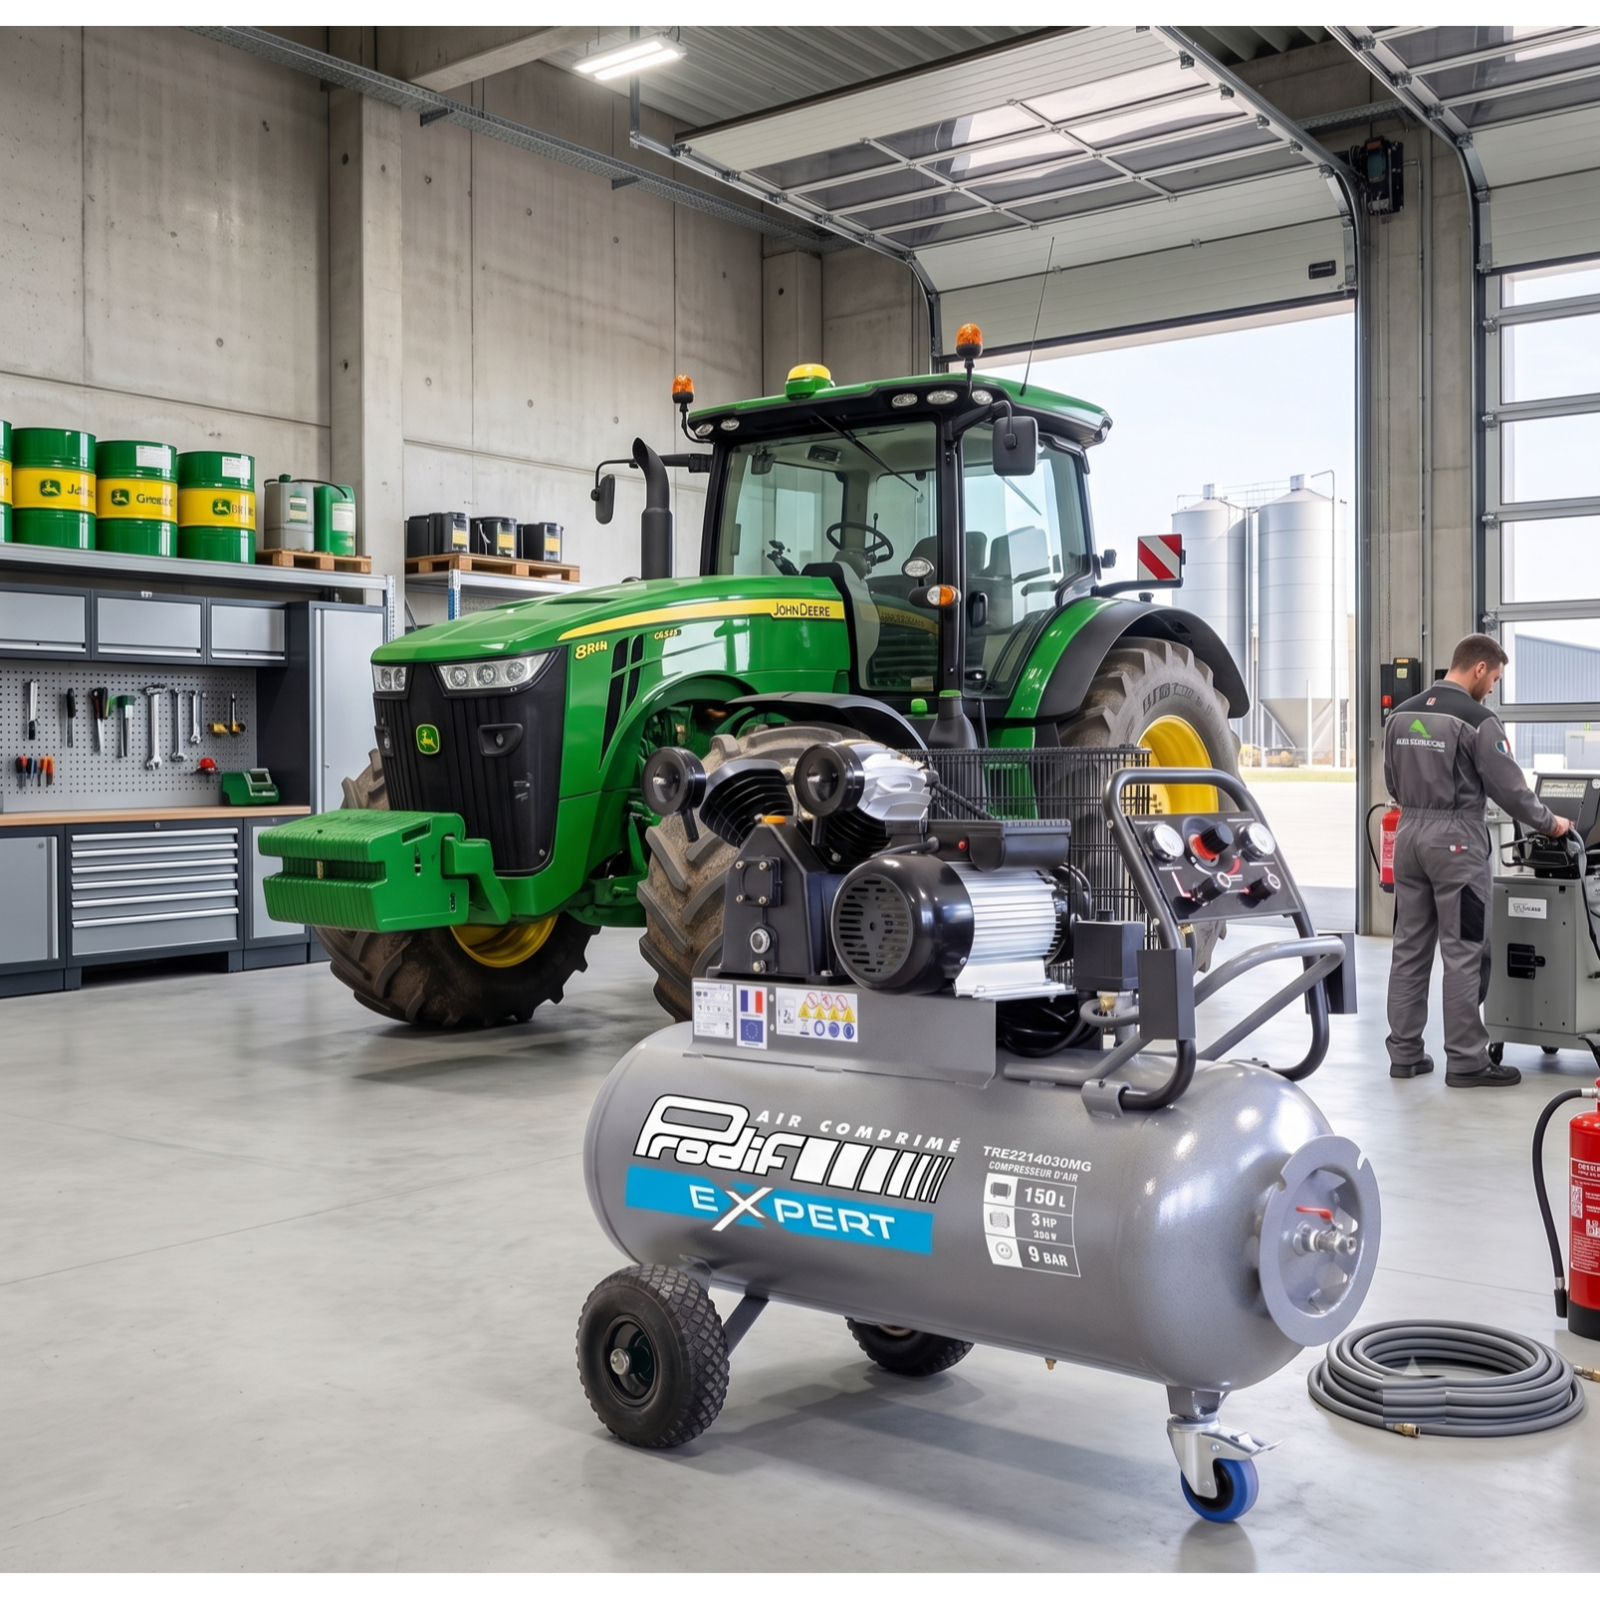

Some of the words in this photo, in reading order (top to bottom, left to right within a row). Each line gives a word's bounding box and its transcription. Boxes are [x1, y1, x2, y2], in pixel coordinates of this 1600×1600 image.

[633, 1093, 807, 1176] Prodif
[756, 1110, 802, 1128] AIR
[819, 1119, 961, 1153] COMPRIMÉ
[983, 1145, 1092, 1172] TRE2214030MG
[988, 1160, 1052, 1179] COMPRESSEUR
[1053, 1172, 1079, 1182] D'AIR
[1024, 1186, 1057, 1207] 150
[1058, 1195, 1067, 1208] L
[688, 1184, 896, 1240] EXPERT
[1031, 1213, 1041, 1227] 3
[1042, 1217, 1058, 1229] HP
[1028, 1245, 1040, 1262] 9
[1042, 1252, 1068, 1267] BAR
